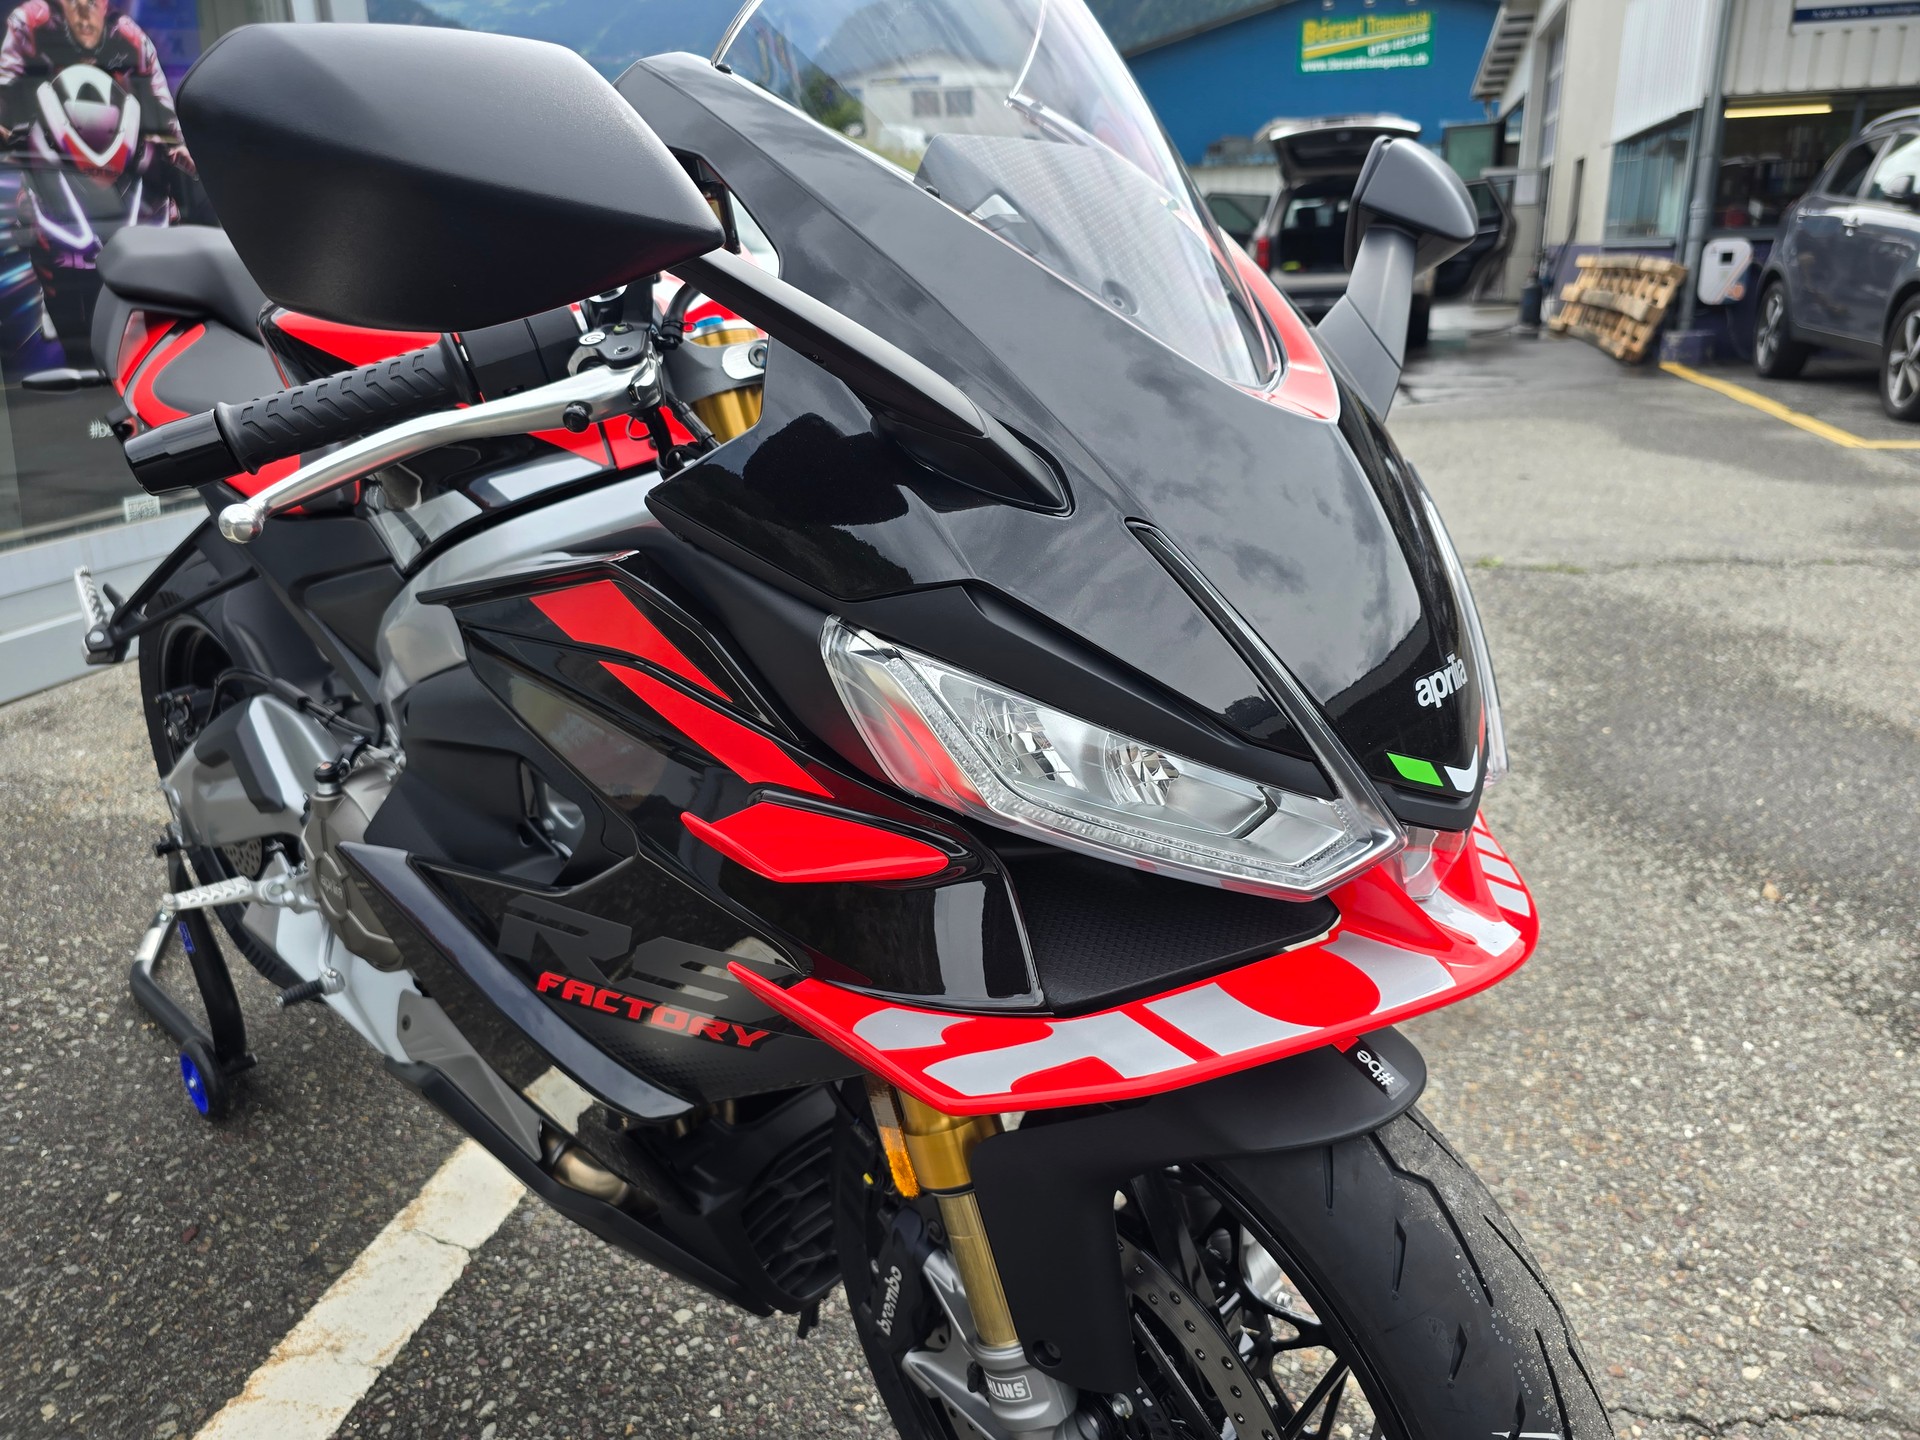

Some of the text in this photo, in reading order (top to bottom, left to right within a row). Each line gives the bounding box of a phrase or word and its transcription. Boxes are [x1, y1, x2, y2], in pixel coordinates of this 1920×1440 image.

[1415, 653, 1468, 708] aprilia
[497, 893, 798, 1024] RS
[535, 971, 770, 1048] FACTORY
[875, 1265, 903, 1337] brembo
[986, 1379, 1027, 1399] HLINS
